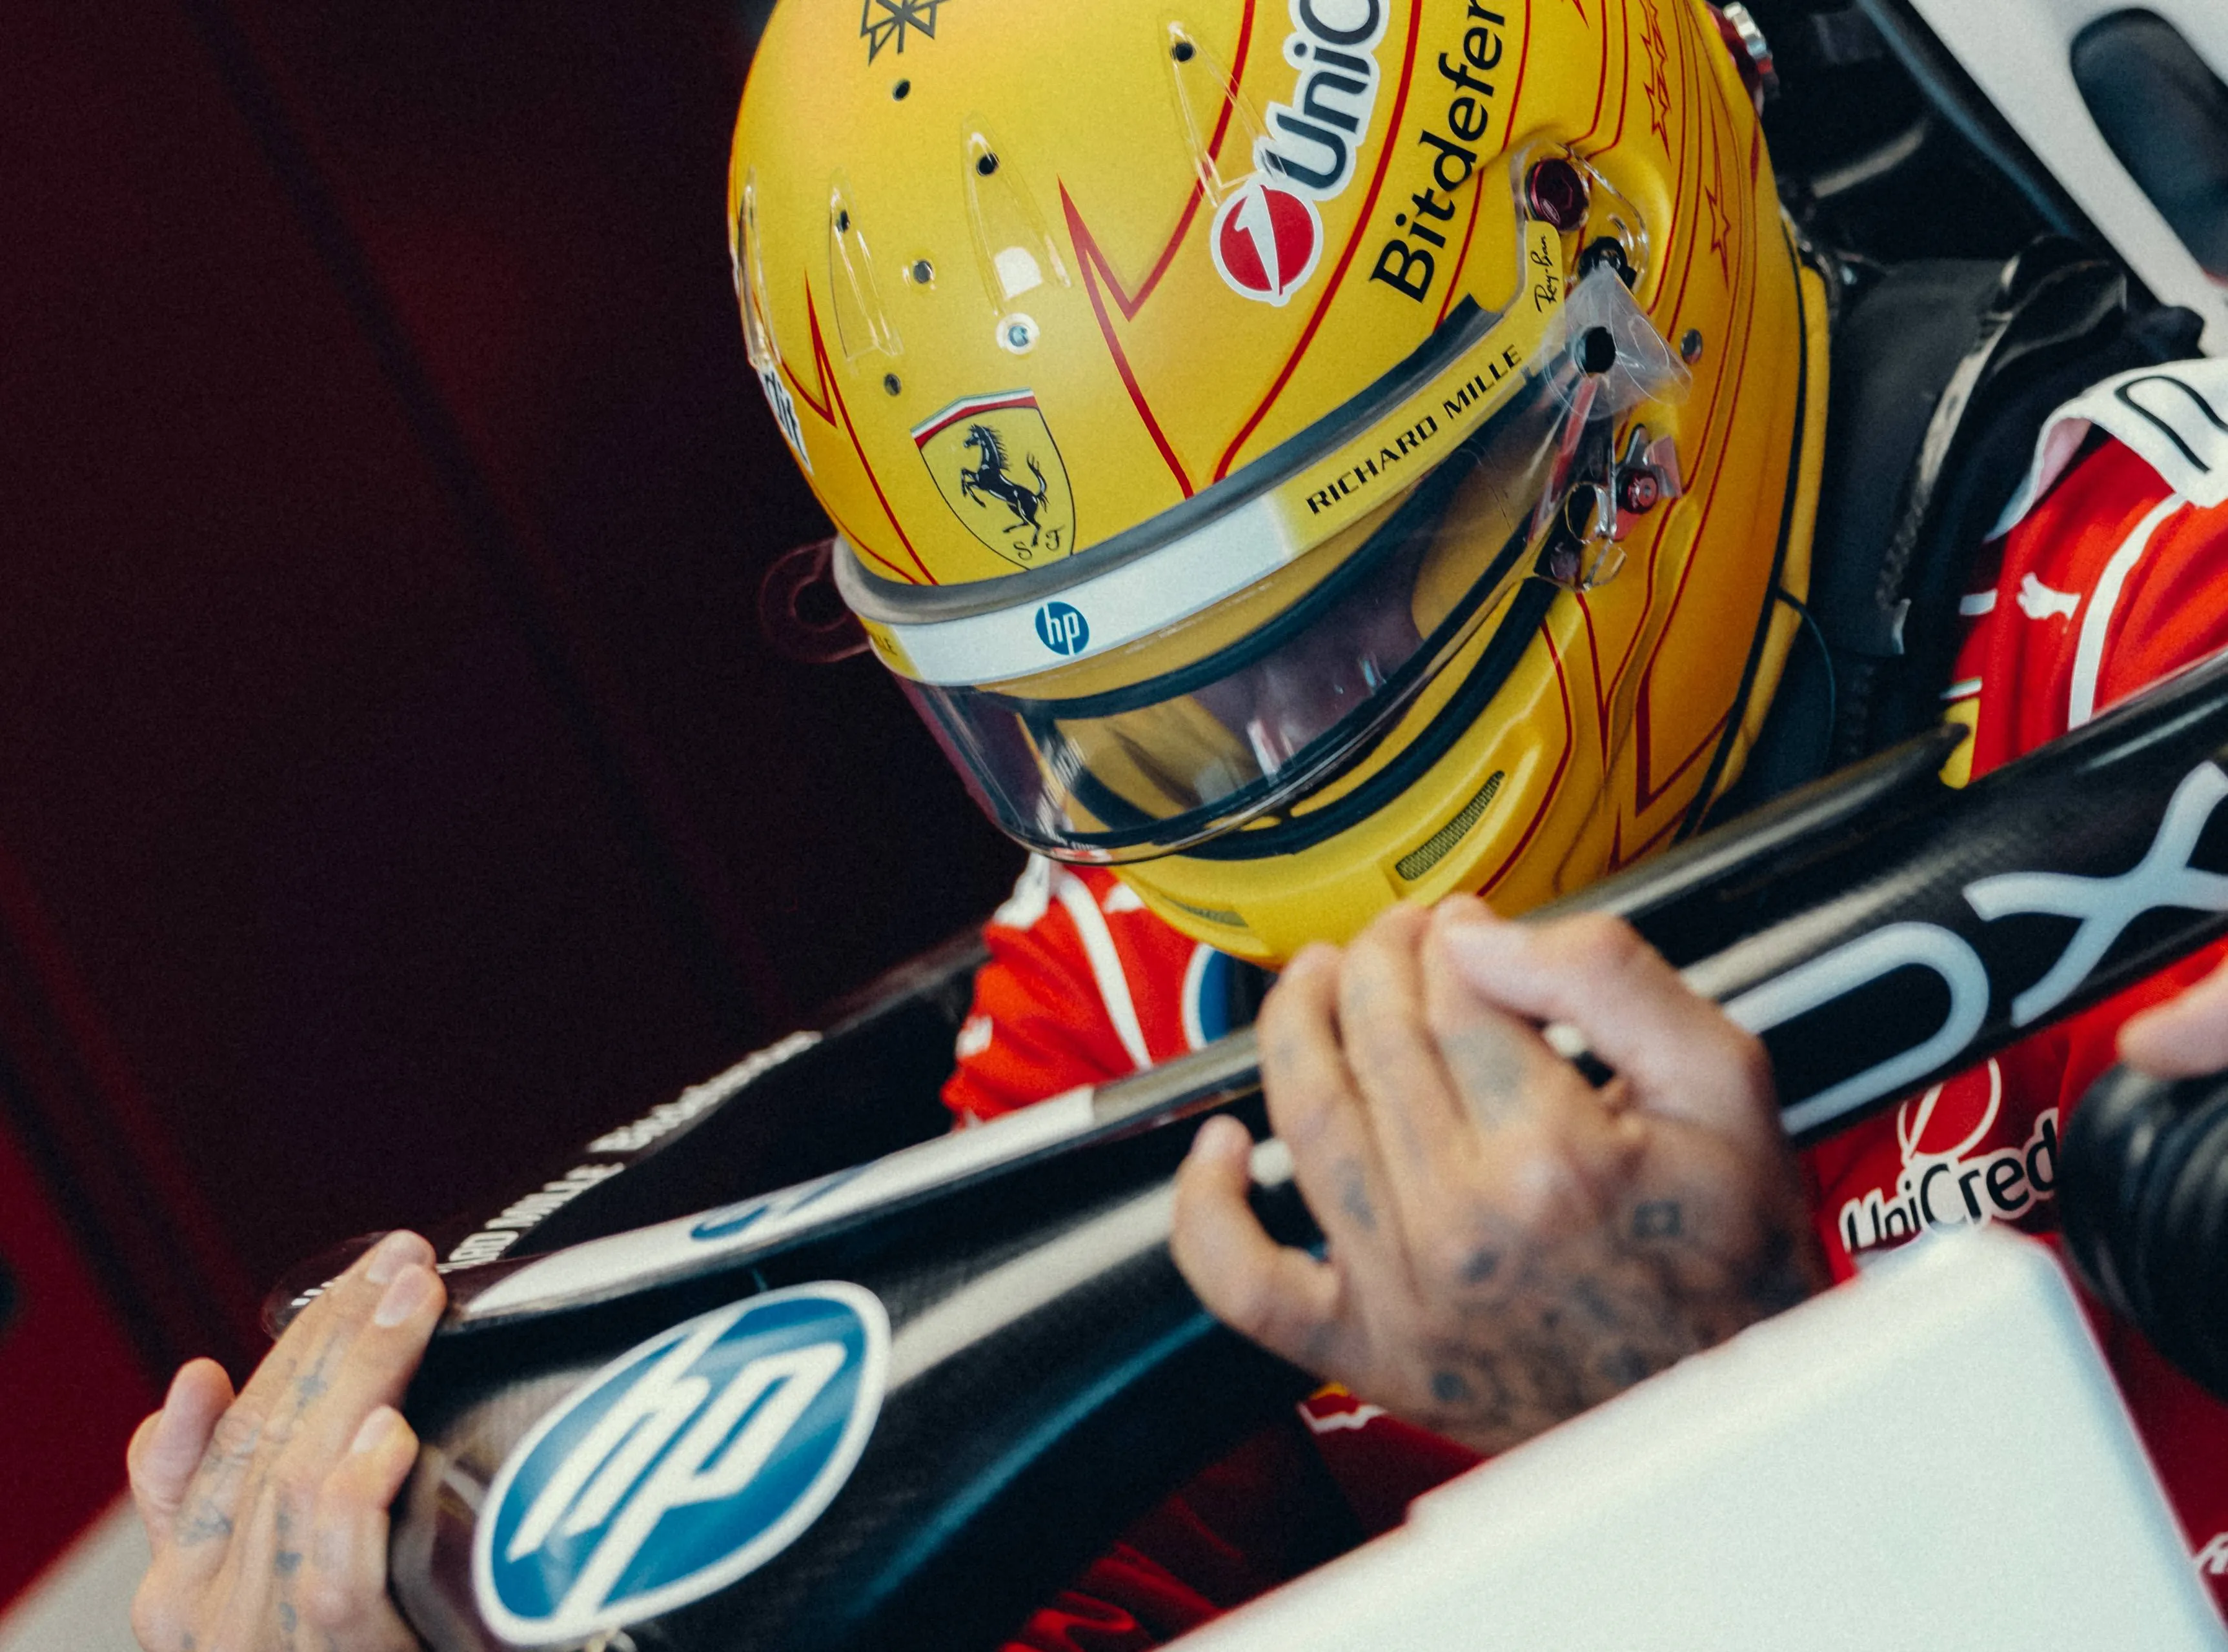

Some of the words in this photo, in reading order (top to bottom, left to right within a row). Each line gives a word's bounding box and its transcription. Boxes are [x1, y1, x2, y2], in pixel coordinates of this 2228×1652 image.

[1264, 0, 1380, 189] UniC
[1530, 234, 1559, 313] Ray-Ban
[1306, 416, 1439, 515] RICHARD
[1443, 343, 1523, 419] MILLE
[1013, 540, 1033, 560] S
[1040, 601, 1080, 656] hp
[505, 1304, 848, 1621] hp
